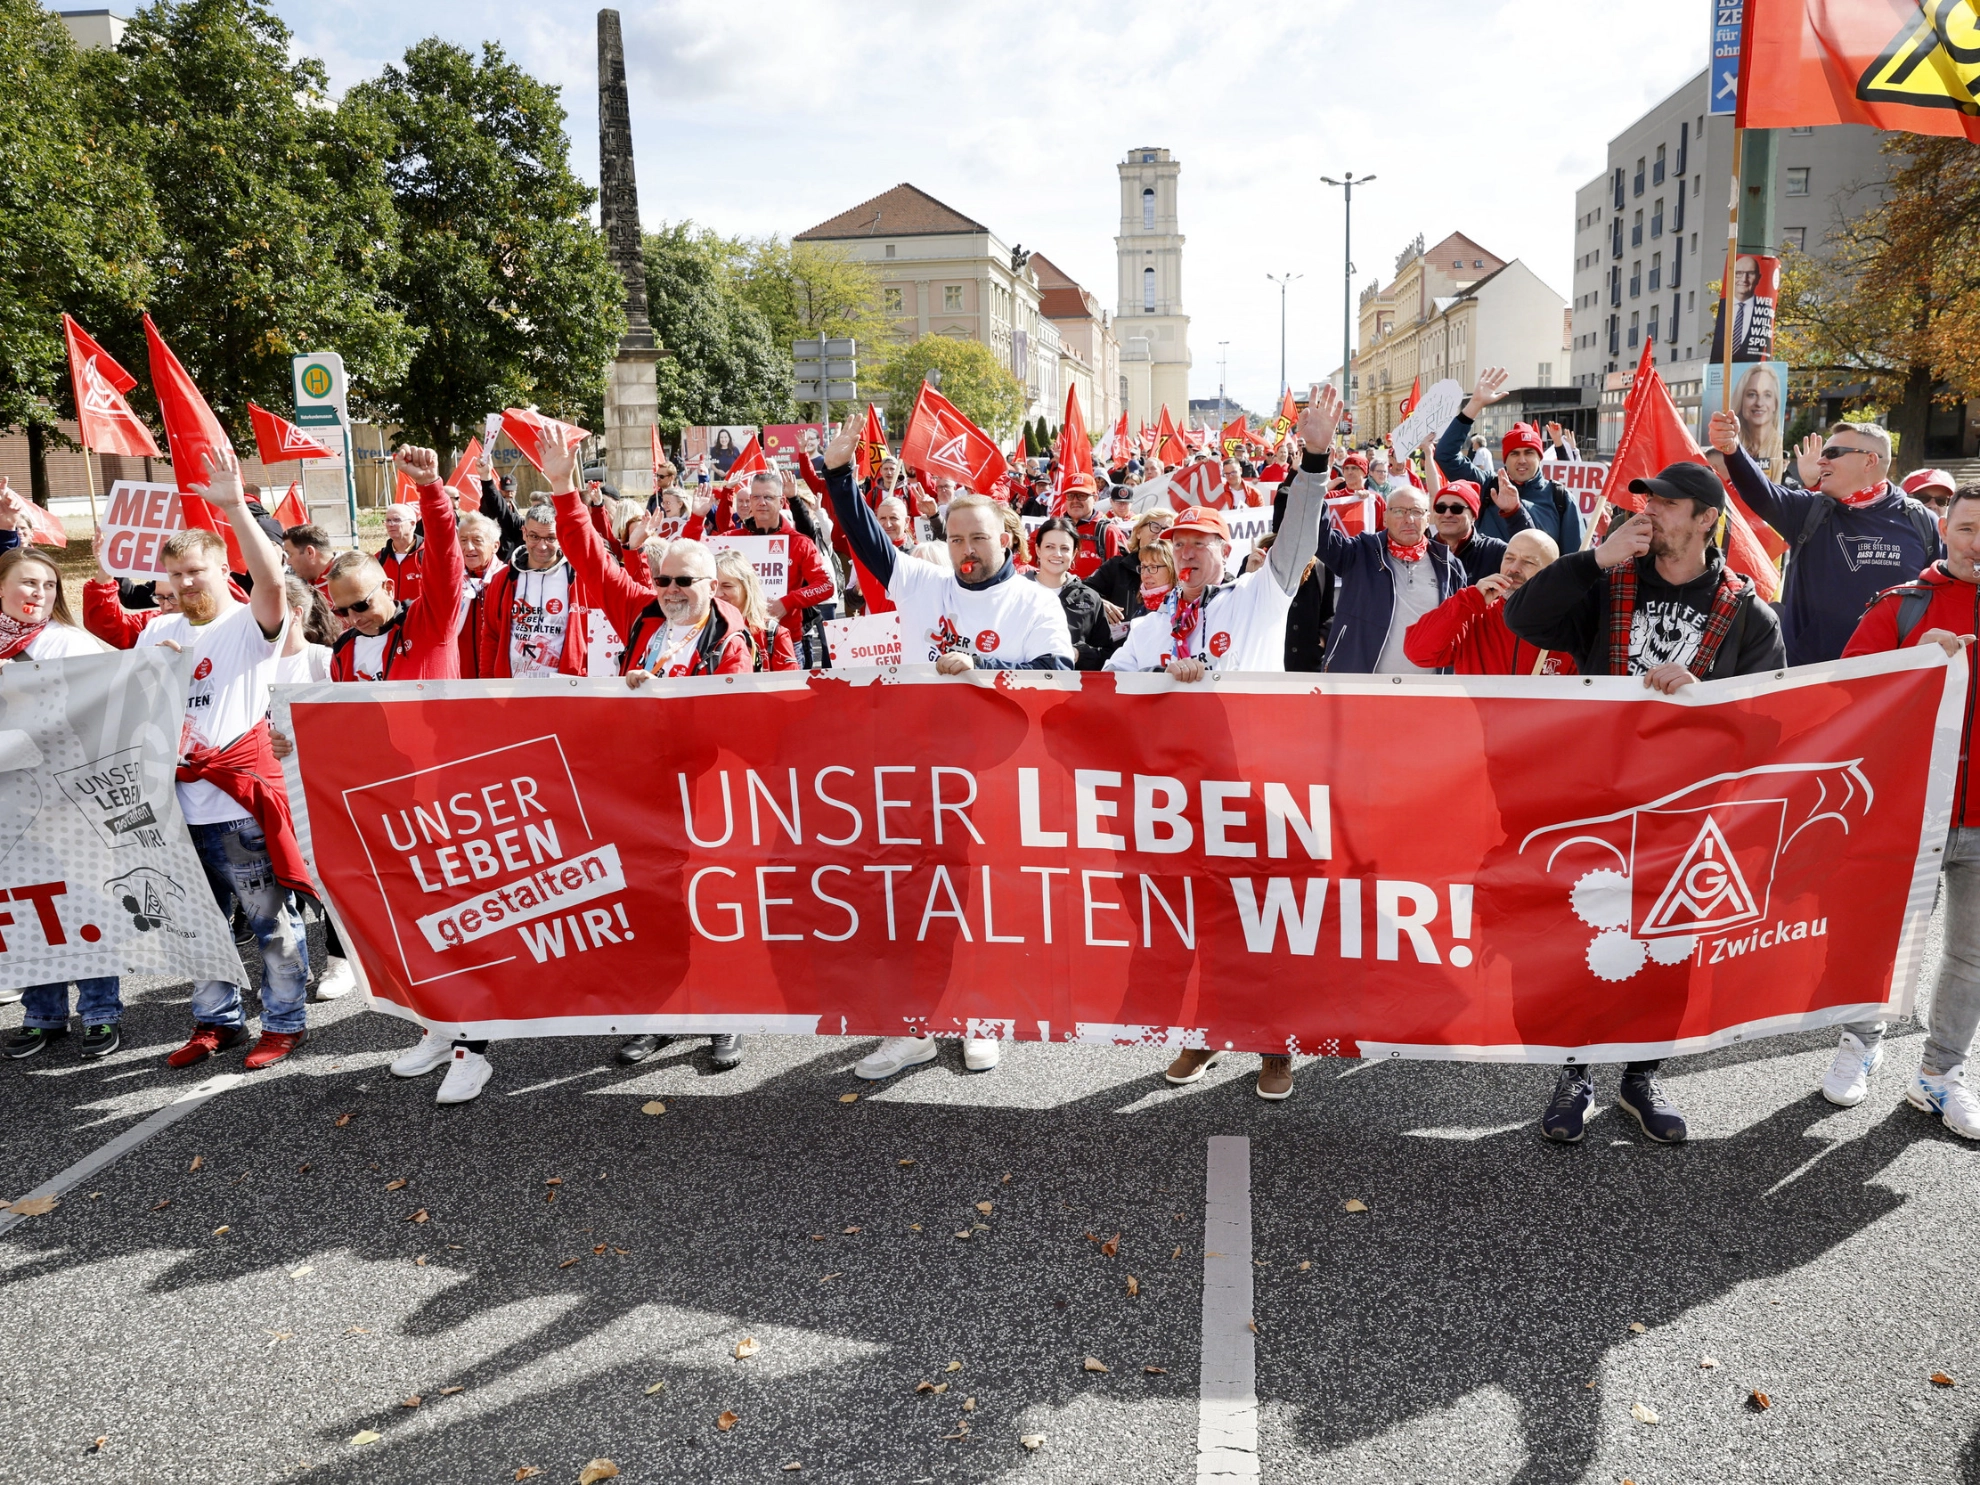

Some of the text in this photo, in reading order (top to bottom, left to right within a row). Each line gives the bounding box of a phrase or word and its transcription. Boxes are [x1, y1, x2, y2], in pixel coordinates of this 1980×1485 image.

[1716, 29, 1739, 42] für
[1748, 337, 1768, 348] SPD.
[1875, 551, 1887, 559] DIE
[851, 642, 902, 659] SOLIDAR
[133, 828, 167, 849] WIR!
[381, 776, 548, 851] UNSER
[678, 765, 1333, 861] UNSER LEBEN
[408, 818, 563, 894] LEBEN
[436, 854, 608, 948] gestalten
[687, 864, 1475, 969] GESTALTEN WIR!
[517, 901, 635, 965] WIR!
[1708, 917, 1828, 965] Zwickau
